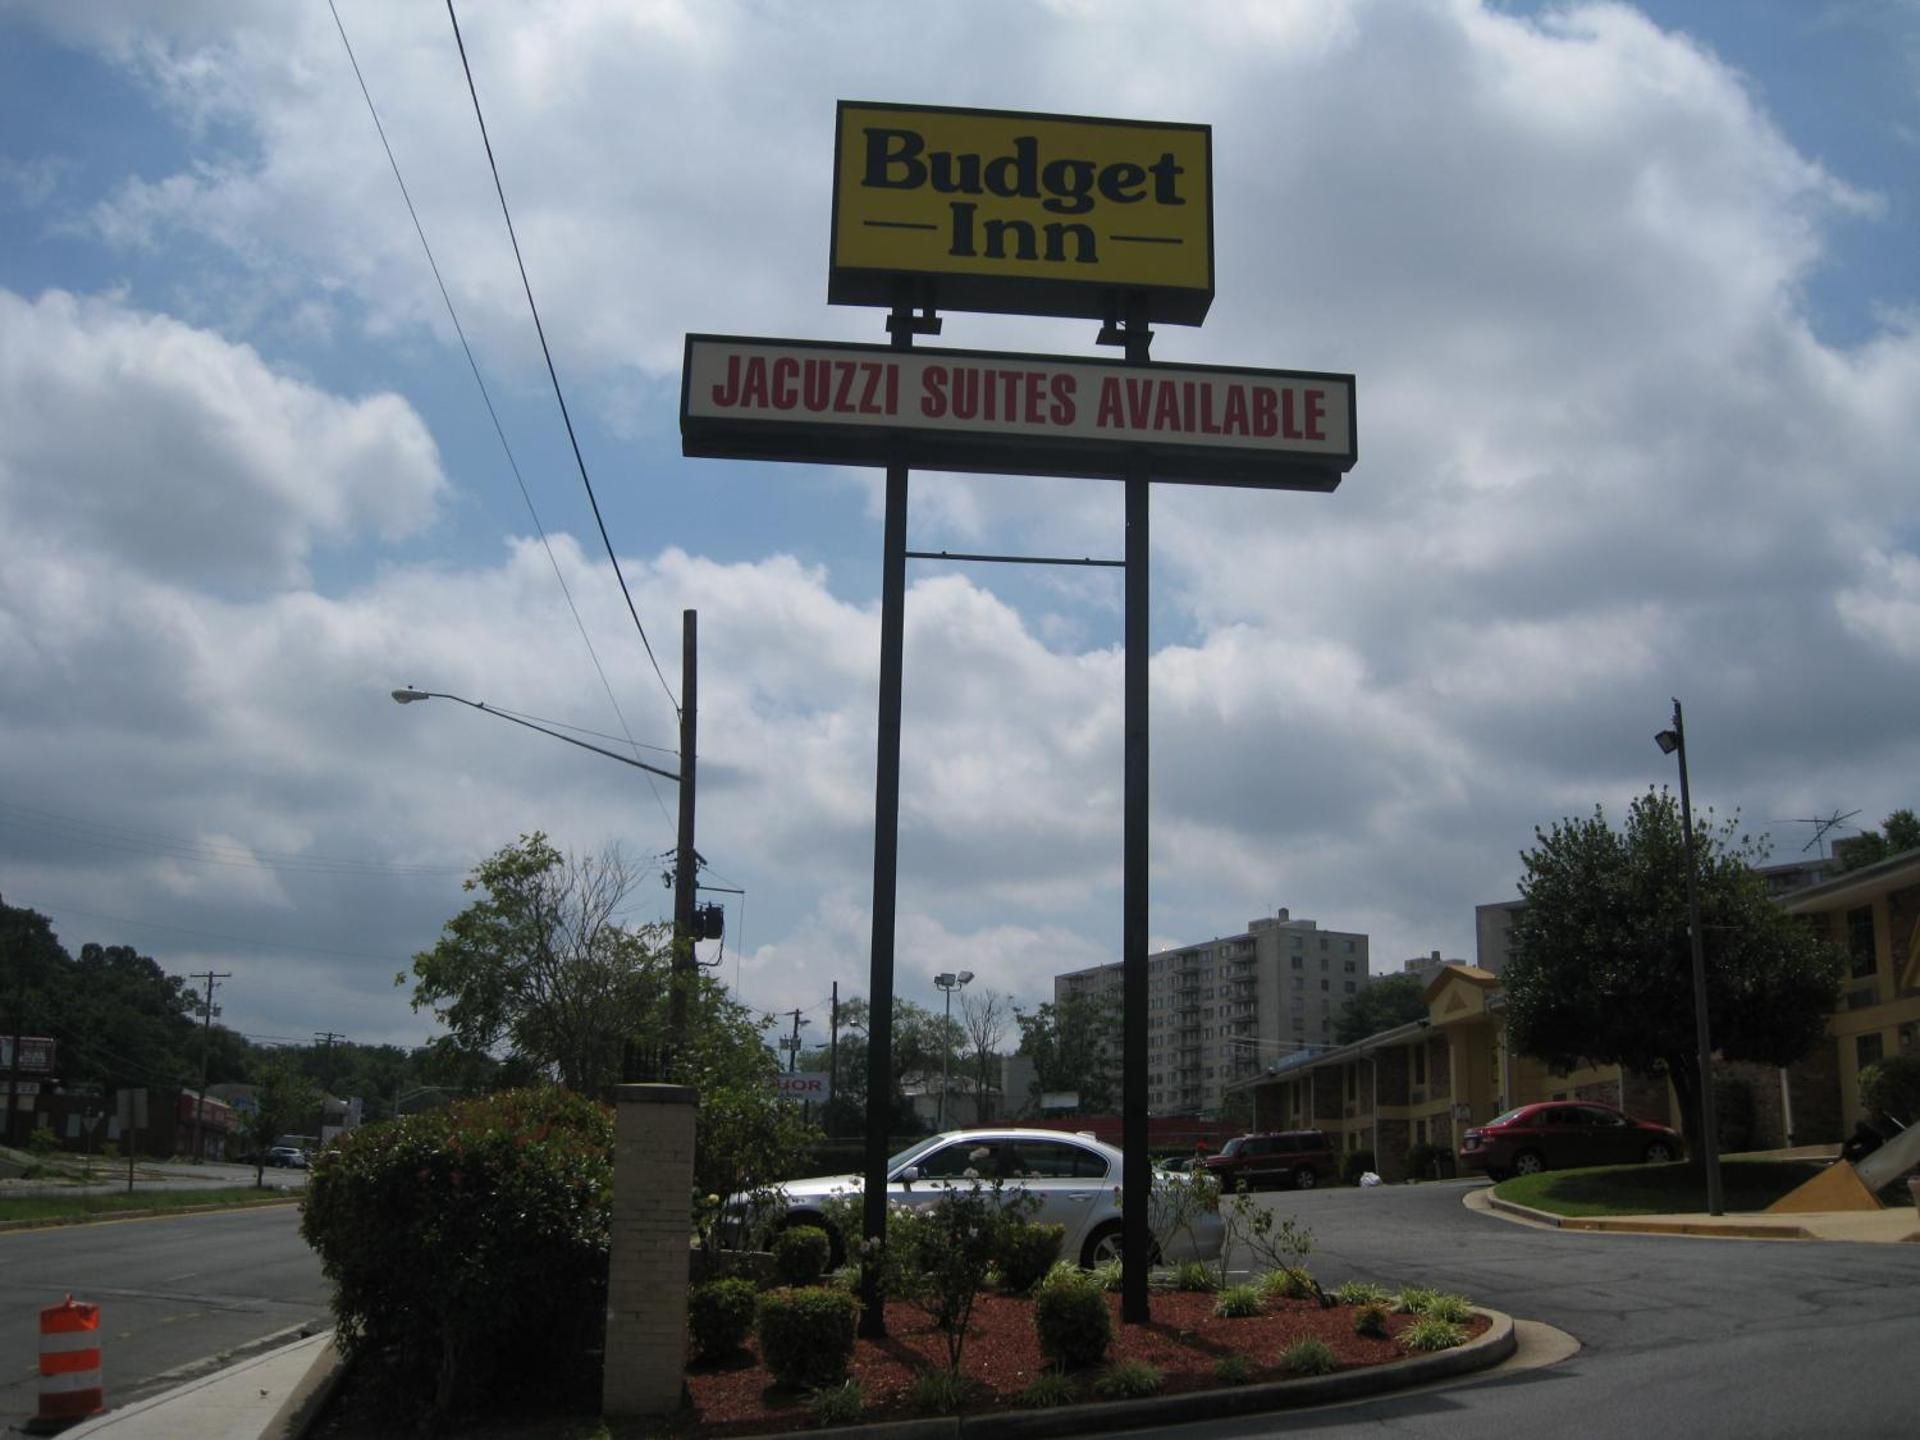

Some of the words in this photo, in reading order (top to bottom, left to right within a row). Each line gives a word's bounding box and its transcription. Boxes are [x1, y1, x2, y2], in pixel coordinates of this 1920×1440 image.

[861, 127, 1186, 214] Budget
[948, 201, 1098, 263] Inn
[713, 354, 898, 417] JACUZZI
[921, 365, 1077, 426] SUITES
[1097, 376, 1327, 442] AVAILABLE
[772, 1079, 822, 1091] UOR
